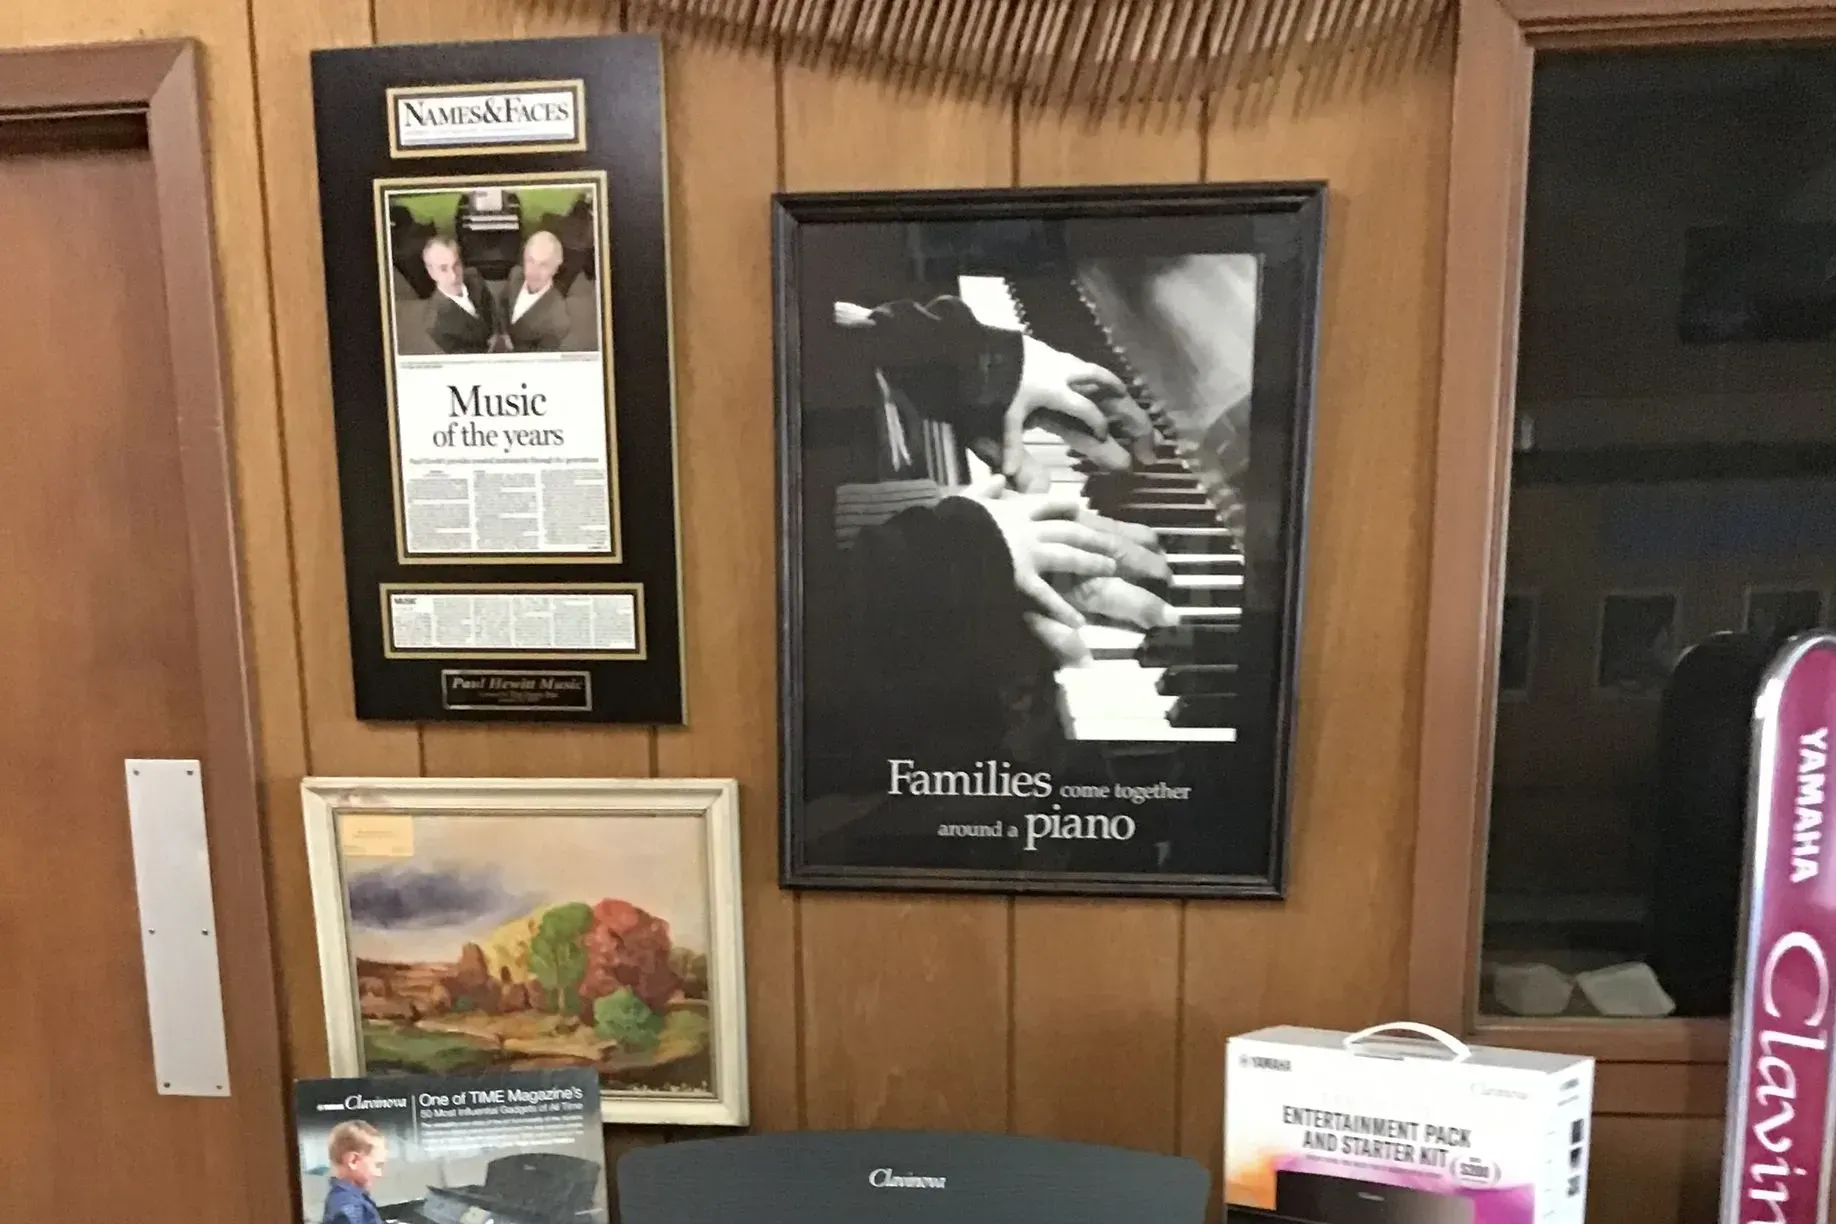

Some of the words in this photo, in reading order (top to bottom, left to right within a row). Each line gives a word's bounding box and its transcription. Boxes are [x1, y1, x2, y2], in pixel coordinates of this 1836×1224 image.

[447, 383, 547, 417] Music
[433, 422, 458, 447] of
[461, 422, 499, 447] the
[503, 427, 565, 453] years
[452, 677, 486, 690] Paul
[489, 677, 536, 690] Hewitt
[539, 679, 584, 691] Music
[887, 758, 1053, 798] Families
[1059, 783, 1110, 799] come
[1113, 781, 1192, 805] together
[1789, 726, 1828, 884] YAMAHA
[937, 820, 1002, 838] around
[1006, 824, 1019, 838] a
[1023, 803, 1136, 850] piano
[418, 1093, 450, 1107] One
[451, 1091, 467, 1106] of
[468, 1090, 505, 1104] TIME
[507, 1086, 584, 1104] Magazine's
[1282, 1104, 1420, 1142] ENTERTAINMENT
[1424, 1123, 1472, 1148] PACK
[1302, 1129, 1338, 1153] AND
[1341, 1135, 1415, 1164] STARTER
[1419, 1145, 1449, 1169] KIT
